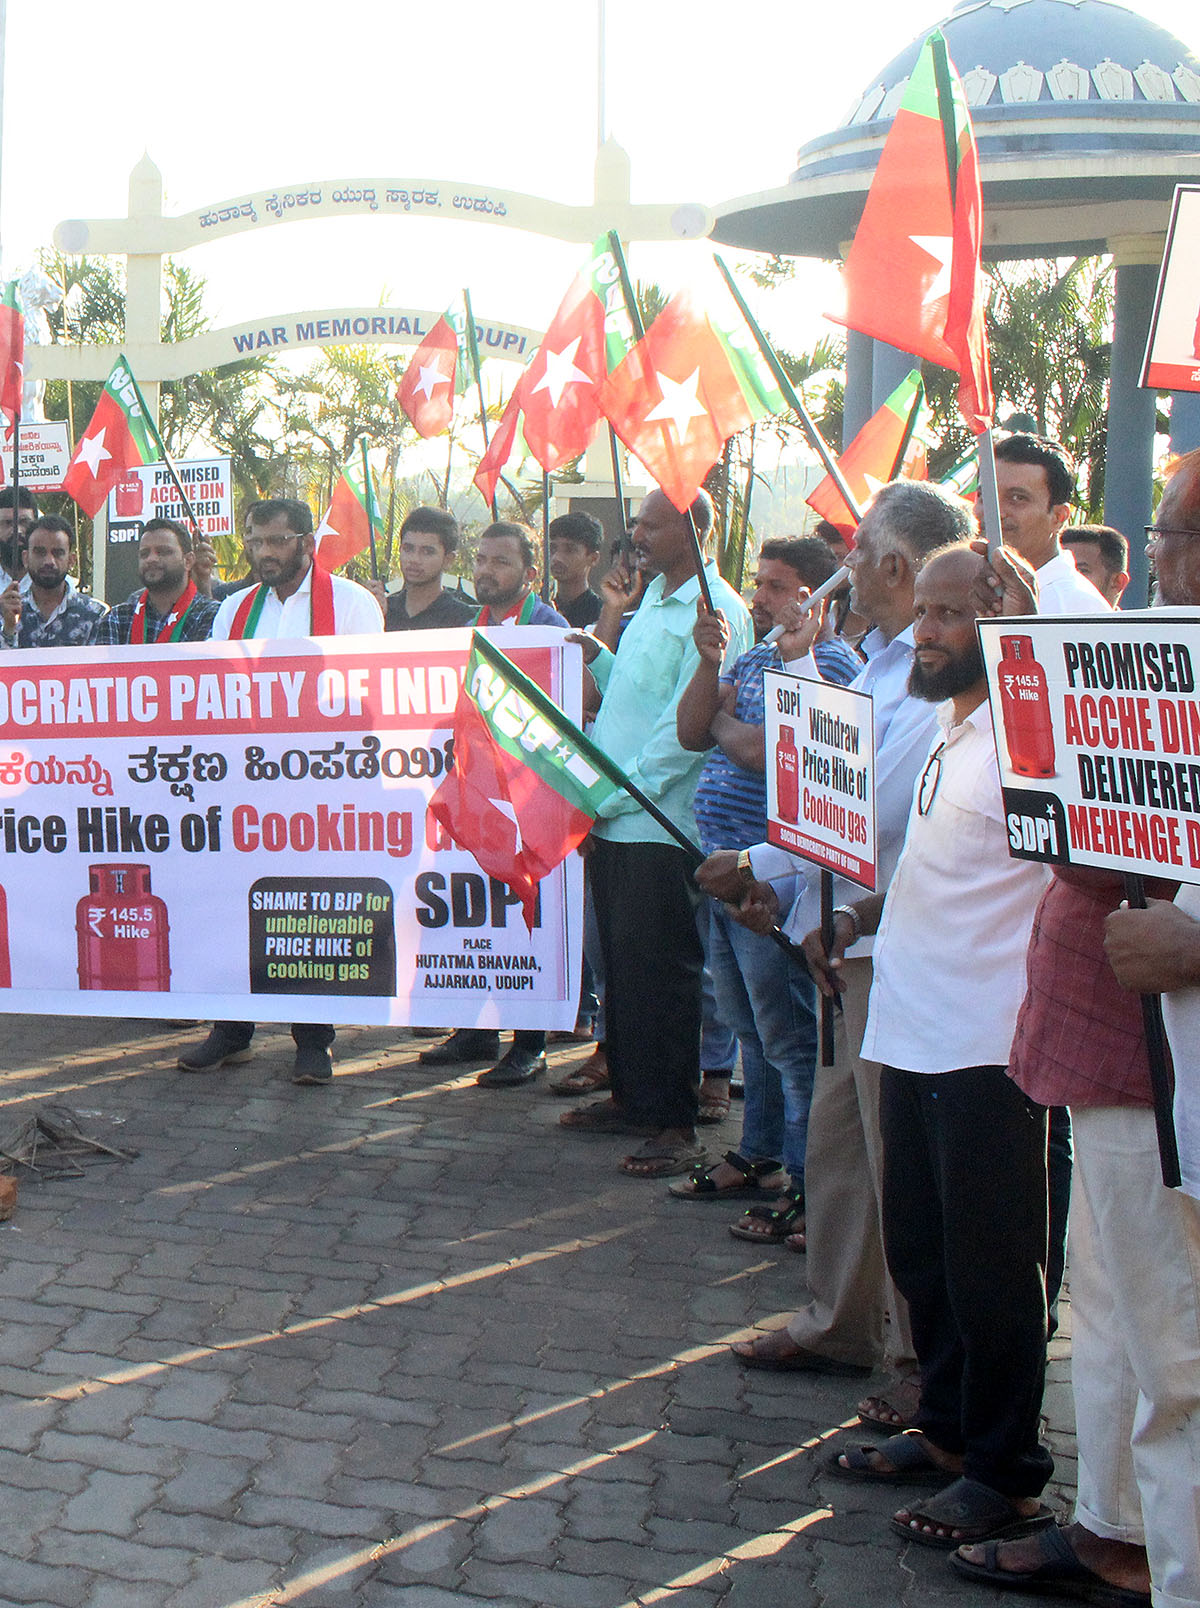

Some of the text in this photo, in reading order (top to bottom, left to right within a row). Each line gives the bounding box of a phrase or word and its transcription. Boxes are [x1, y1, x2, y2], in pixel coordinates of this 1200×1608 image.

[232, 316, 527, 354] WAR MEMORIAL DUPI
[155, 467, 219, 485] PRMISED
[200, 482, 224, 500] DIN
[207, 516, 229, 533] DIN
[1063, 641, 1194, 693] PROMISED
[1015, 675, 1039, 687] 145.5
[170, 671, 306, 721] PARTY
[317, 667, 370, 717] OF
[380, 666, 466, 715] IND
[1019, 689, 1039, 701] Hike
[808, 707, 860, 756] Withdraw
[1063, 694, 1155, 751] ACCHE
[128, 744, 227, 802] ತಕ್ಷಣ
[802, 746, 867, 802] Price Hike of
[803, 787, 867, 845] Cooking gas
[76, 806, 169, 853] Hike
[180, 805, 222, 852] of
[232, 803, 412, 857] Cooking
[1067, 804, 1183, 867] MEHENGE
[252, 891, 390, 912] SHAME TO BJP for
[110, 907, 153, 922] 145.5
[265, 914, 374, 935] unbelievable
[114, 924, 150, 939] Hike
[265, 936, 373, 957] PRICE HIKE of
[463, 938, 492, 950] PLACE
[266, 960, 370, 981] cooking gas
[416, 954, 542, 972] HUTATMA BHAVANA,
[424, 974, 533, 992] AJJARKAD, UDUPI
